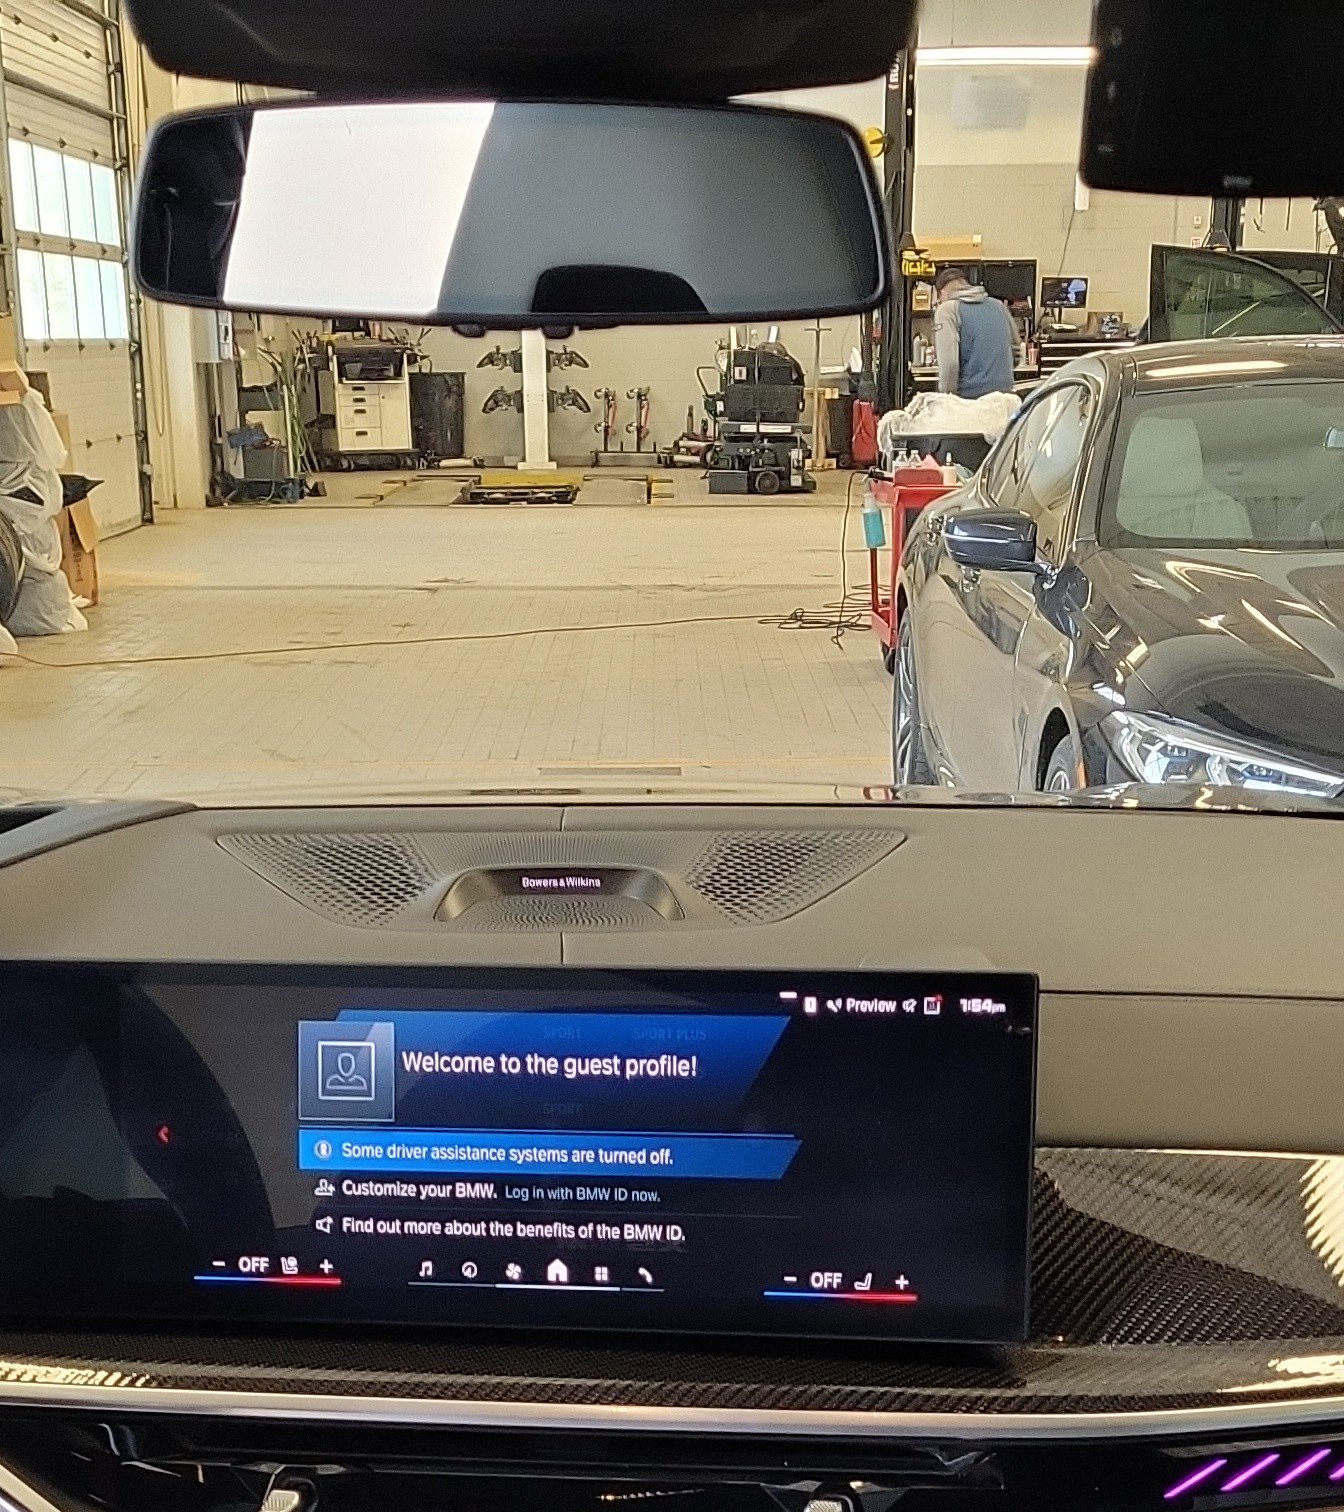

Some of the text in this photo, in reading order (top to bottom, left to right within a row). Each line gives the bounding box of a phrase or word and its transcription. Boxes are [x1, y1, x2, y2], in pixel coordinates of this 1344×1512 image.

[846, 997, 896, 1013] Preview
[402, 1051, 697, 1080] Welcome to the guest profile!
[342, 1143, 674, 1165] Some driver assistance systems are turned off.
[342, 1180, 661, 1202] Customize your BMW. Log in with BMW ID now.
[342, 1217, 686, 1241] Find out more about the benefits of the BMW ID.
[238, 1256, 269, 1273] OFF
[811, 1272, 843, 1289] OFF
